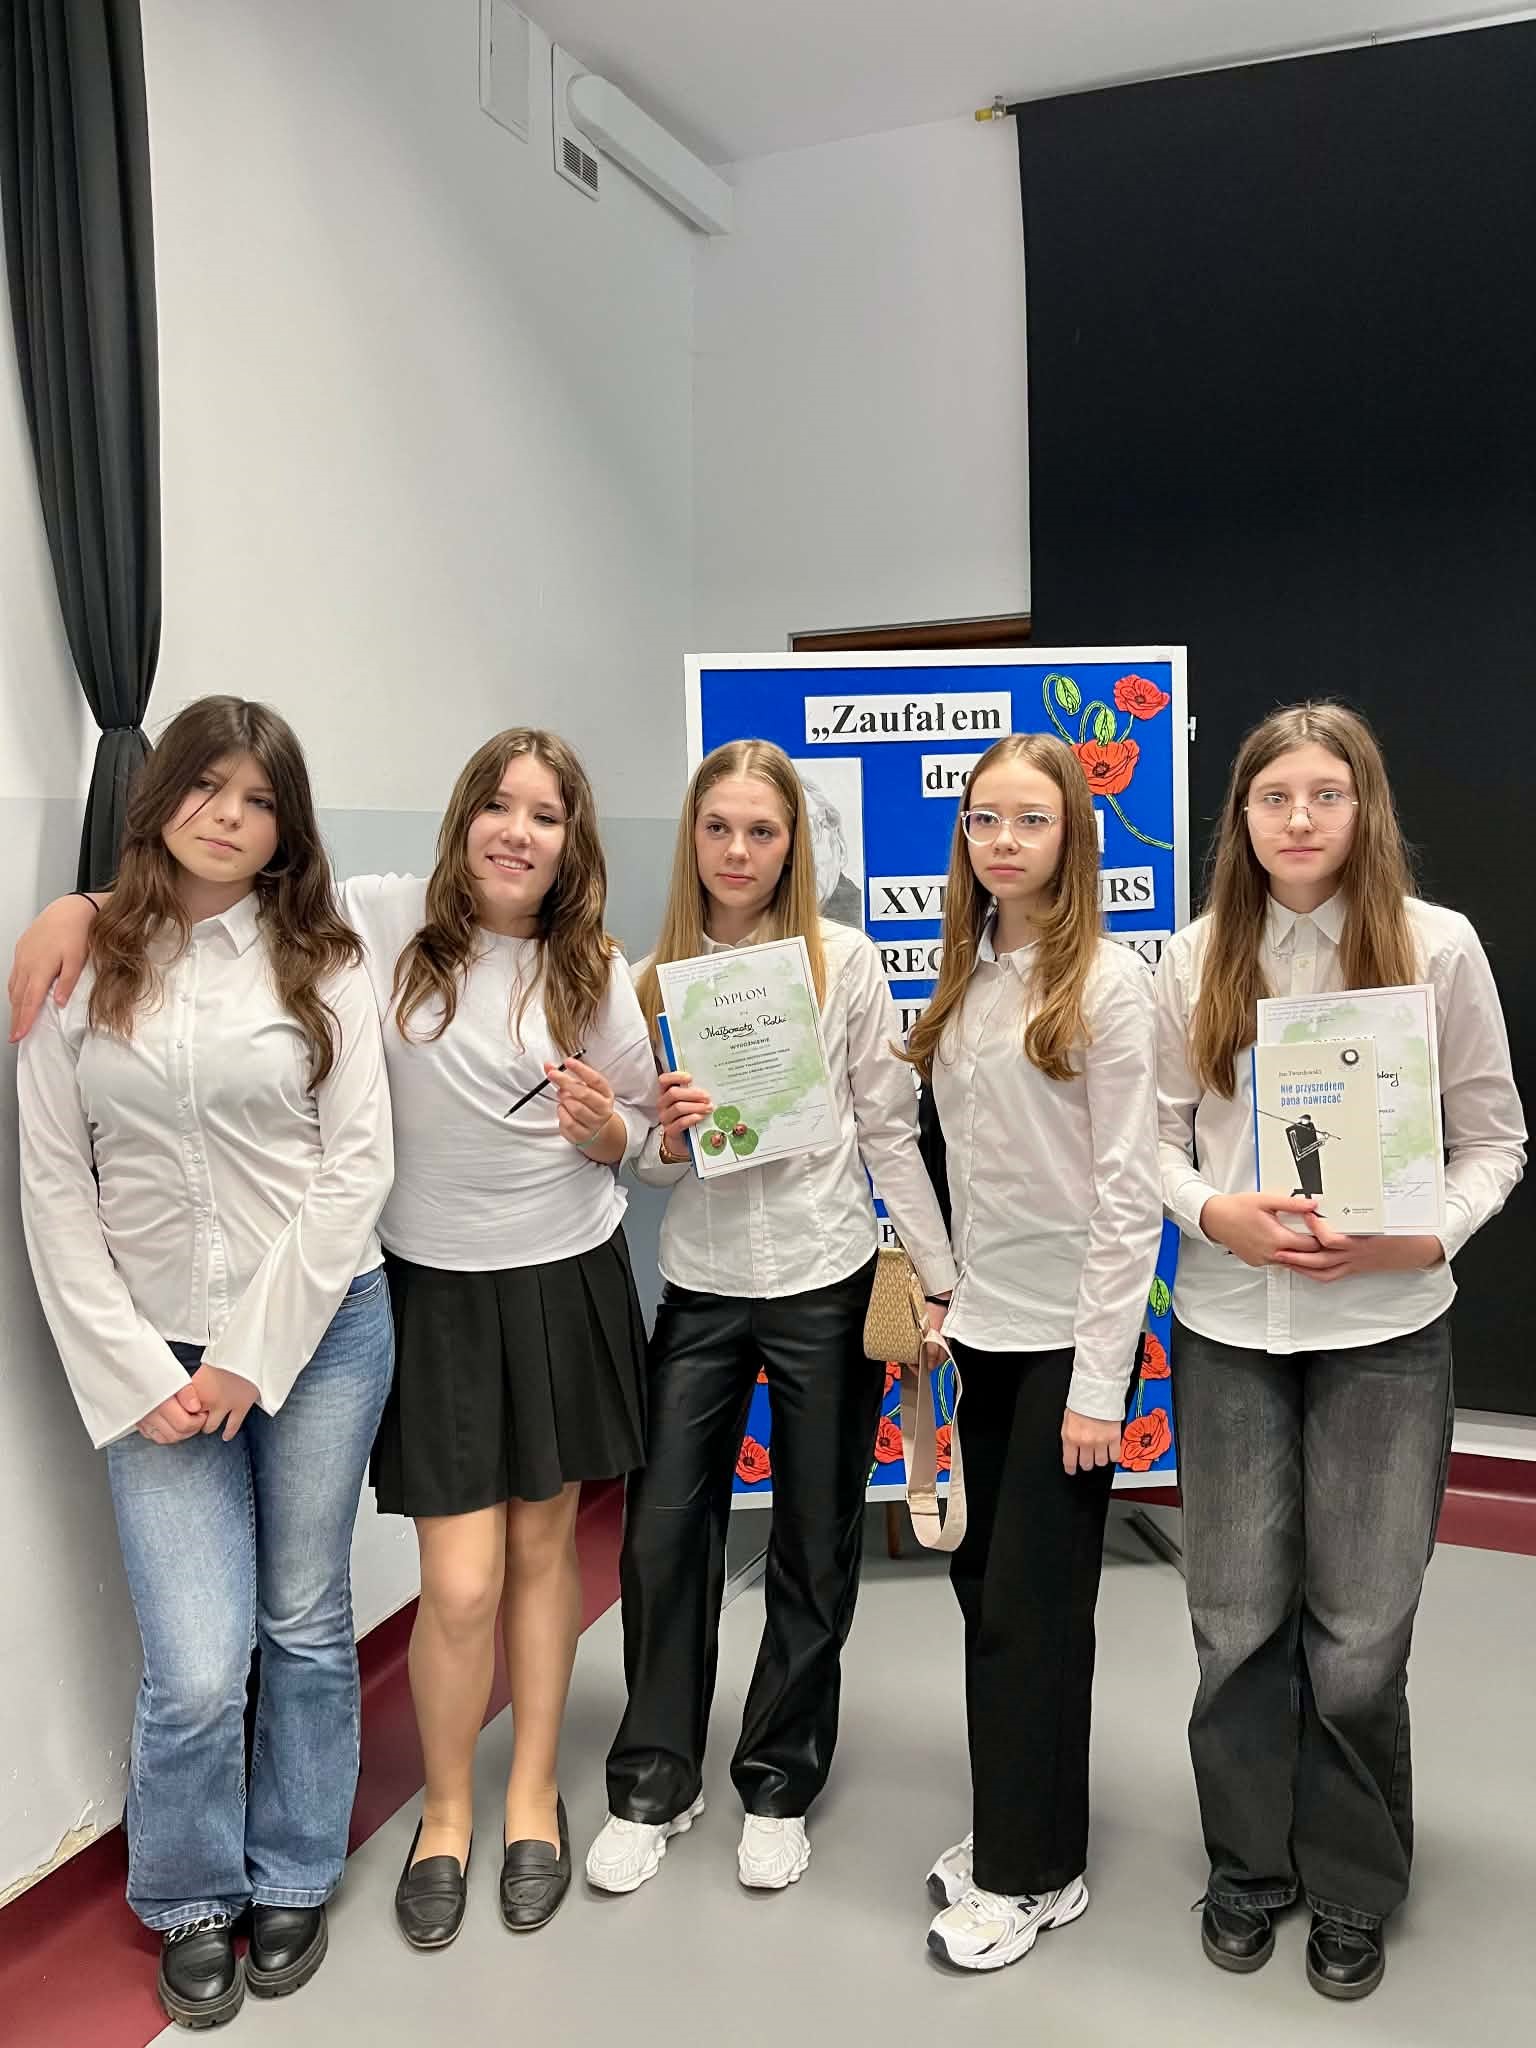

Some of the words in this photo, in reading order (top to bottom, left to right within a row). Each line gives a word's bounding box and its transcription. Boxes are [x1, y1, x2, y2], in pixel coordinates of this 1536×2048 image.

[811, 702, 1001, 741] „Zaufałem
[881, 885, 947, 914] XVI
[713, 986, 768, 1008] DYPLOM
[1280, 1083, 1293, 1094] Nie
[1295, 1081, 1345, 1095] przyszedłem
[1281, 1096, 1300, 1107] pana
[1303, 1093, 1342, 1105] nawracać
